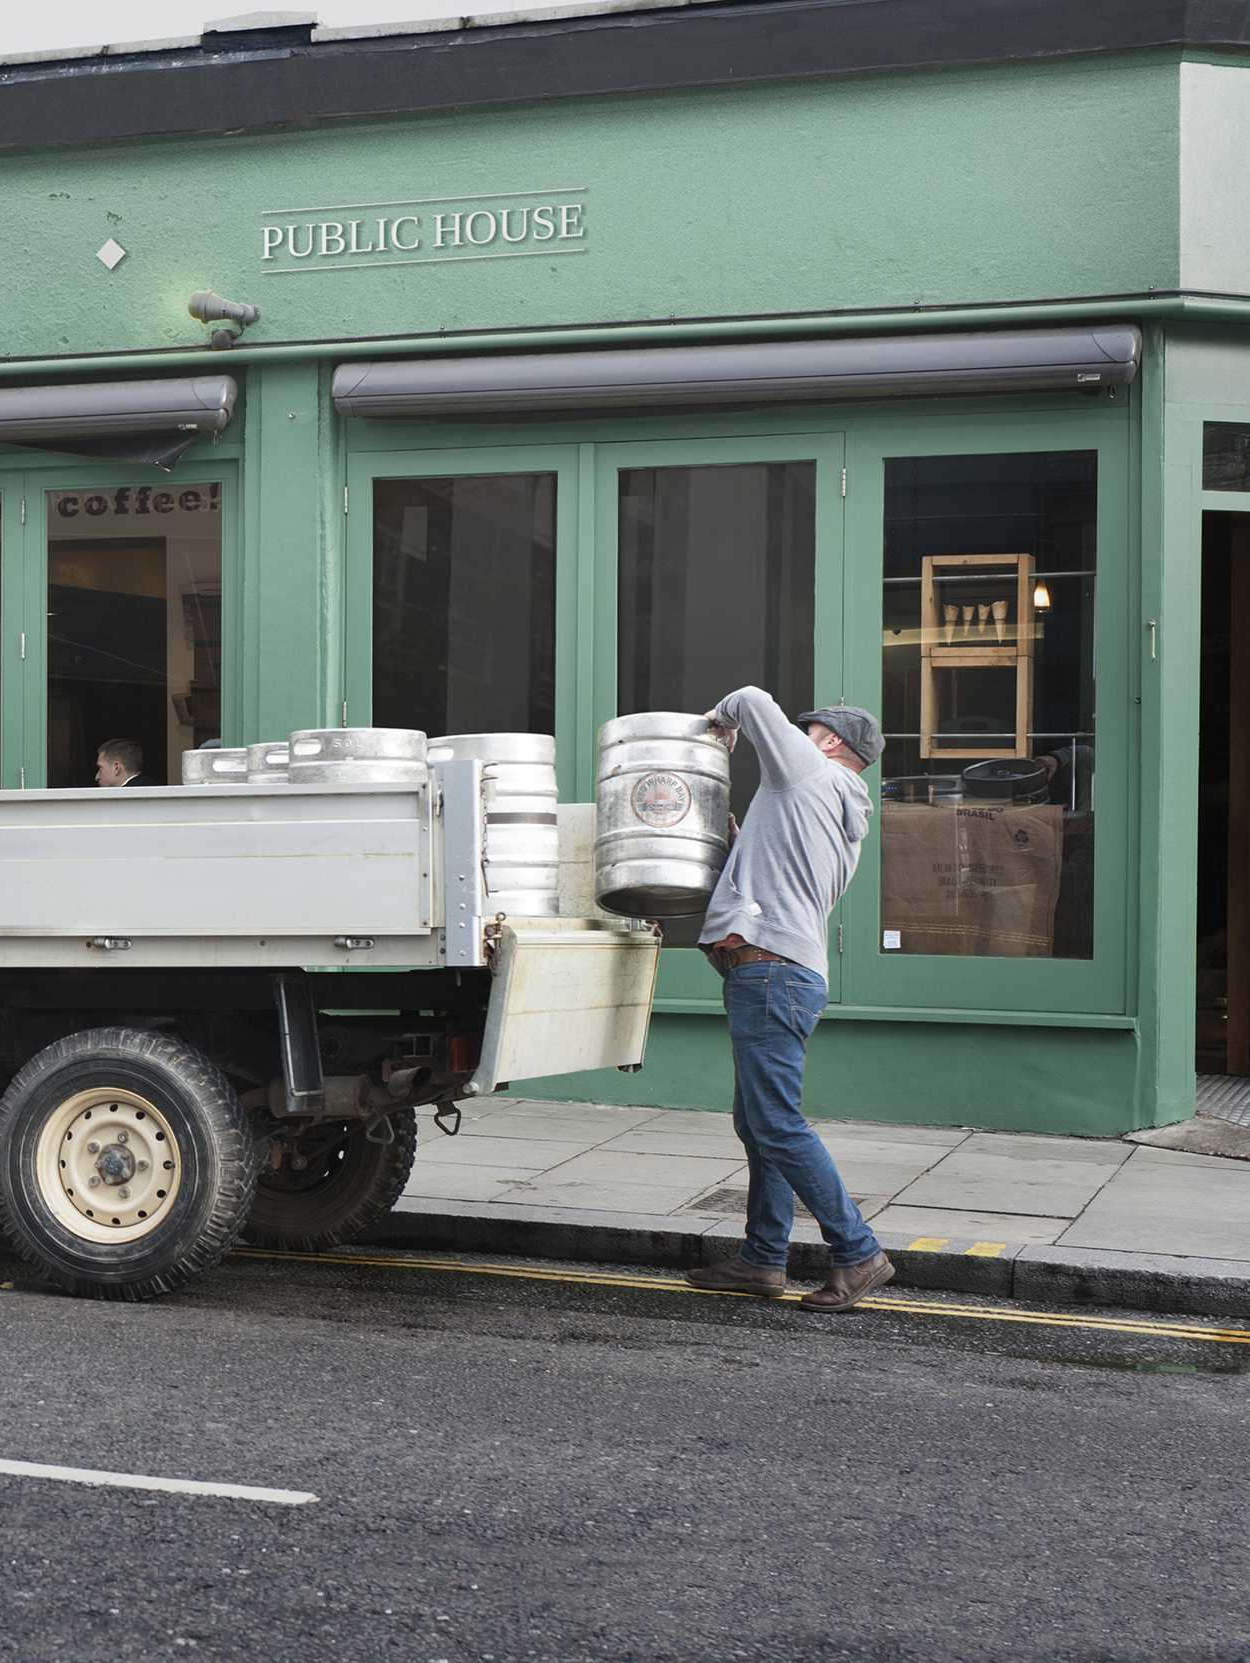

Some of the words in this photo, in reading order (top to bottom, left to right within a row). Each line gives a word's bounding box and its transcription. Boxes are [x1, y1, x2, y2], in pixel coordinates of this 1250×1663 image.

[260, 216, 419, 260] PUBLIC
[432, 203, 584, 248] HOUSE
[57, 483, 220, 518] coffee!
[333, 738, 364, 748] SOL
[636, 785, 648, 803] RED
[645, 776, 679, 788] WHARF
[675, 785, 687, 804] BAY
[956, 808, 995, 821] BRASIL
